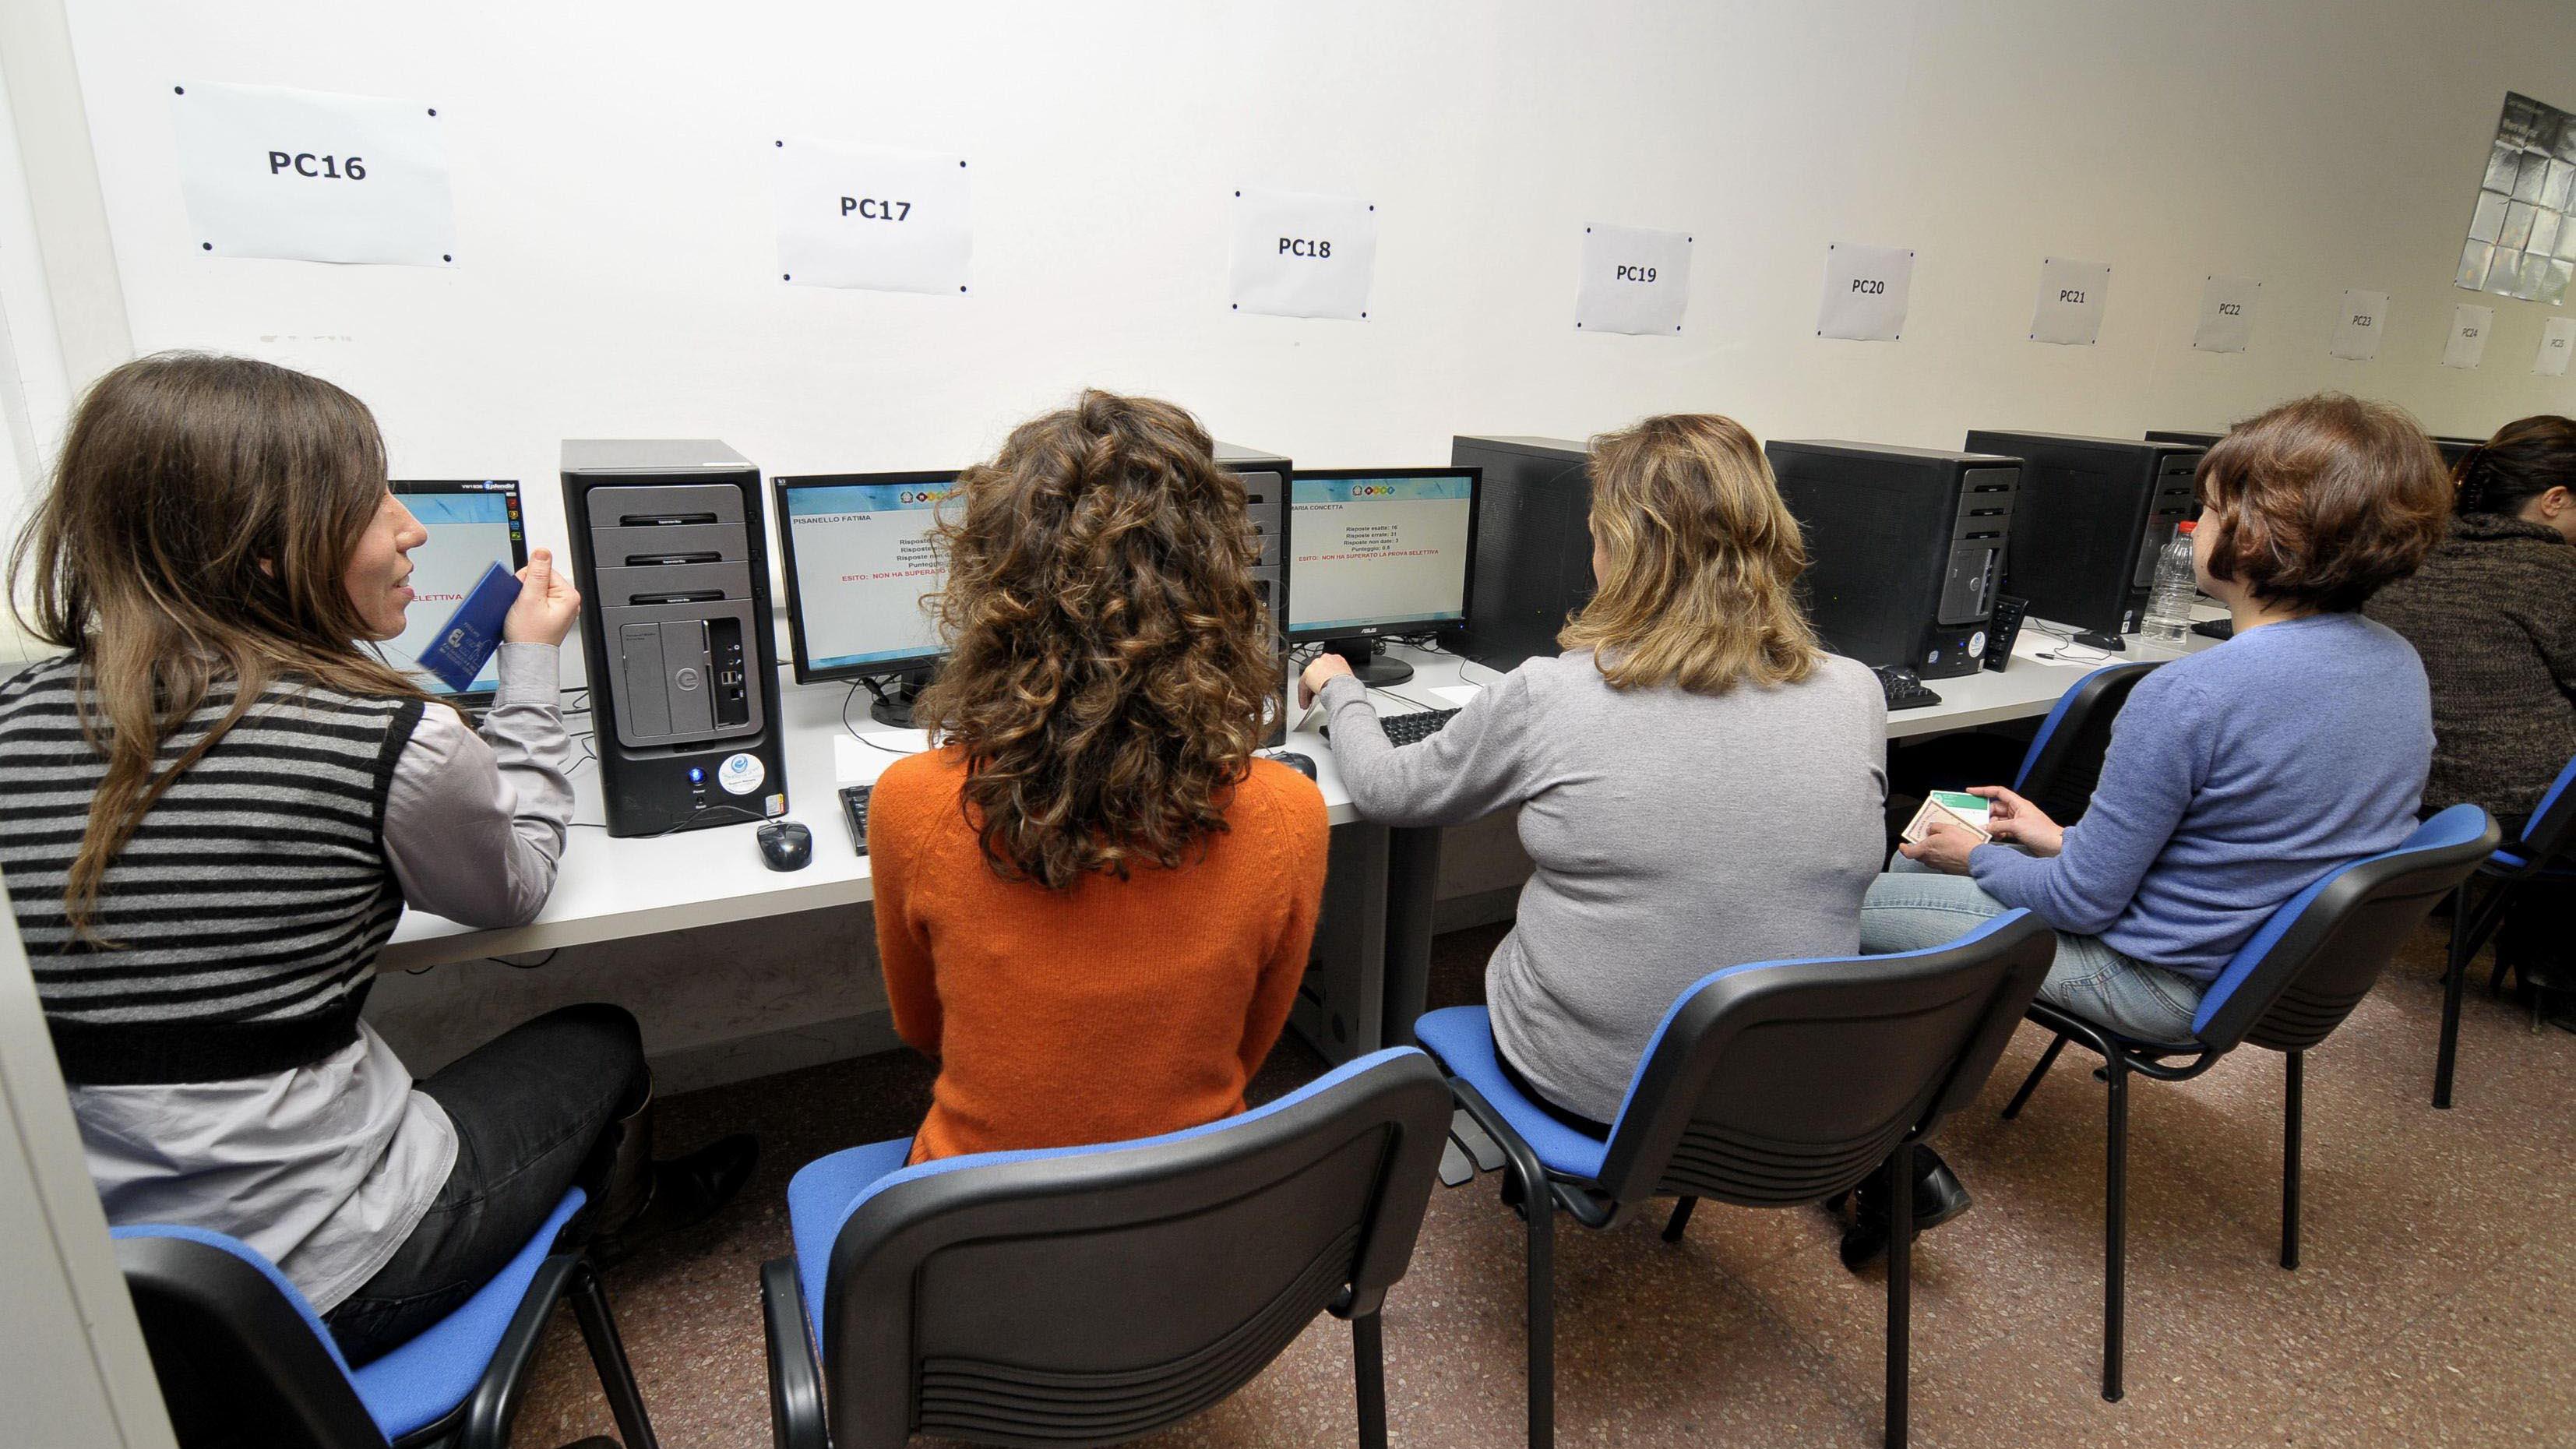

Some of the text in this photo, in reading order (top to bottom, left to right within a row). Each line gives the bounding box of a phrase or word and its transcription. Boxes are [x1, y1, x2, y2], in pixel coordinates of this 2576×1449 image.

[268, 150, 366, 181] PC16
[840, 196, 911, 221] PC17
[1279, 237, 1331, 259] PC18
[1616, 265, 1657, 283] PC19
[1852, 279, 1885, 294] PC20
[2060, 289, 2086, 304] PC21
[2218, 303, 2241, 316] PC22
[2352, 315, 2372, 327] PC23
[2461, 327, 2479, 338] PC24
